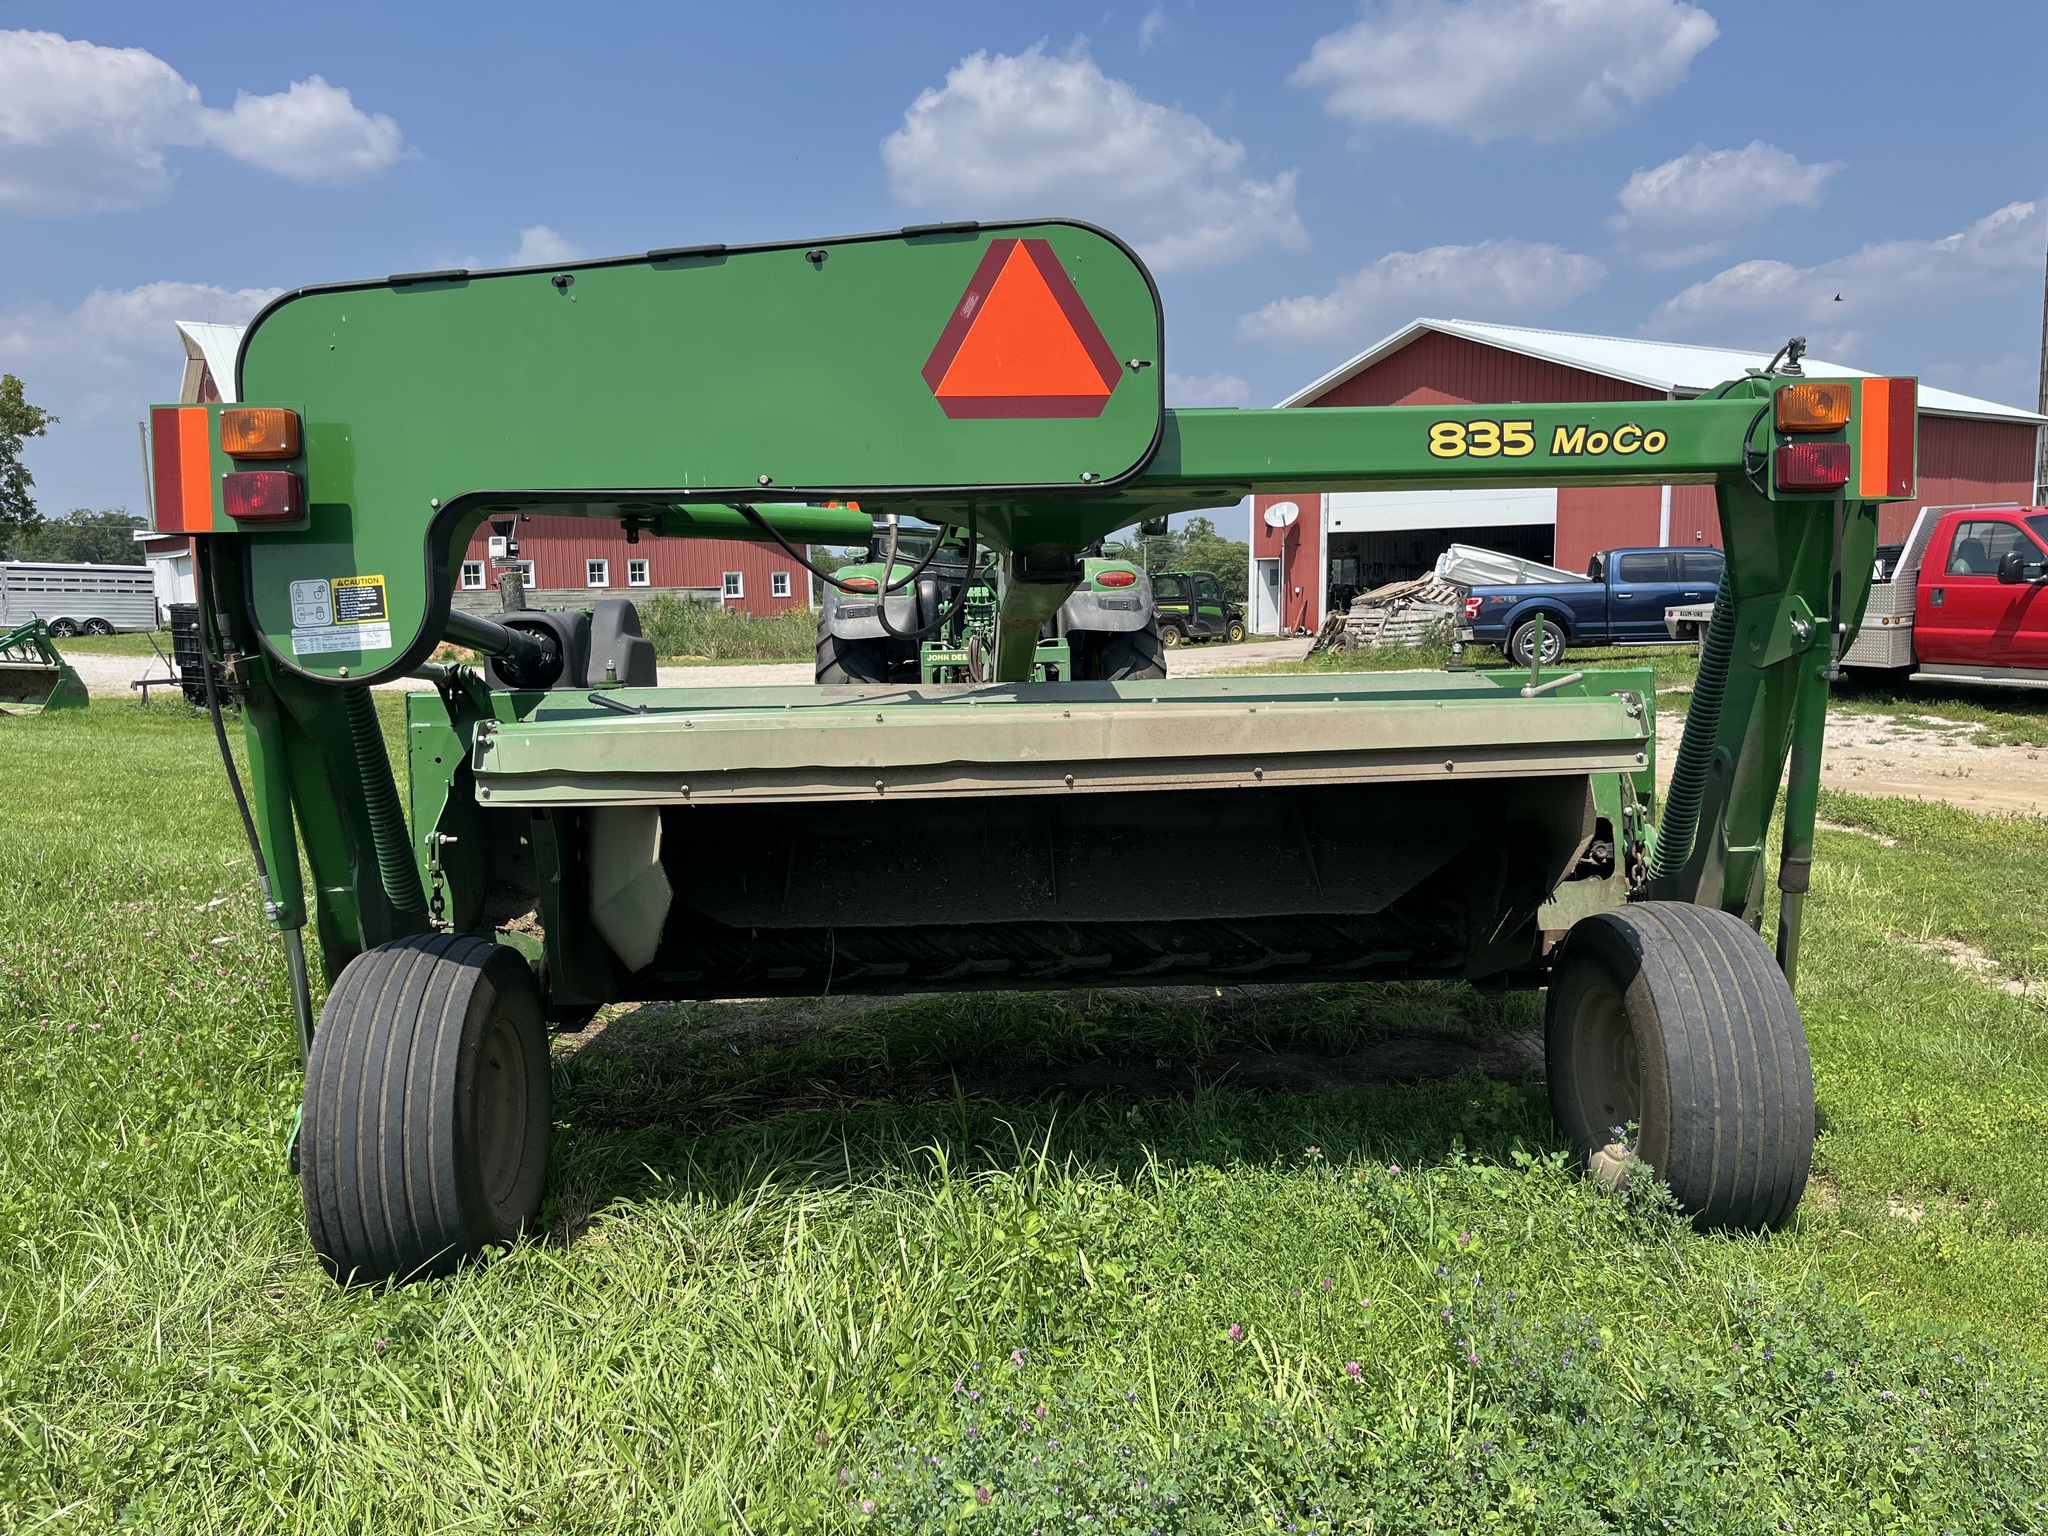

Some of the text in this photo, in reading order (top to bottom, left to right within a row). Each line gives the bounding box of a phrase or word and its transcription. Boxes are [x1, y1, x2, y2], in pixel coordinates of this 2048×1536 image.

[1428, 419, 1668, 458] 835 MoCo
[343, 577, 379, 587] CAUTION
[951, 653, 968, 661] DEE
